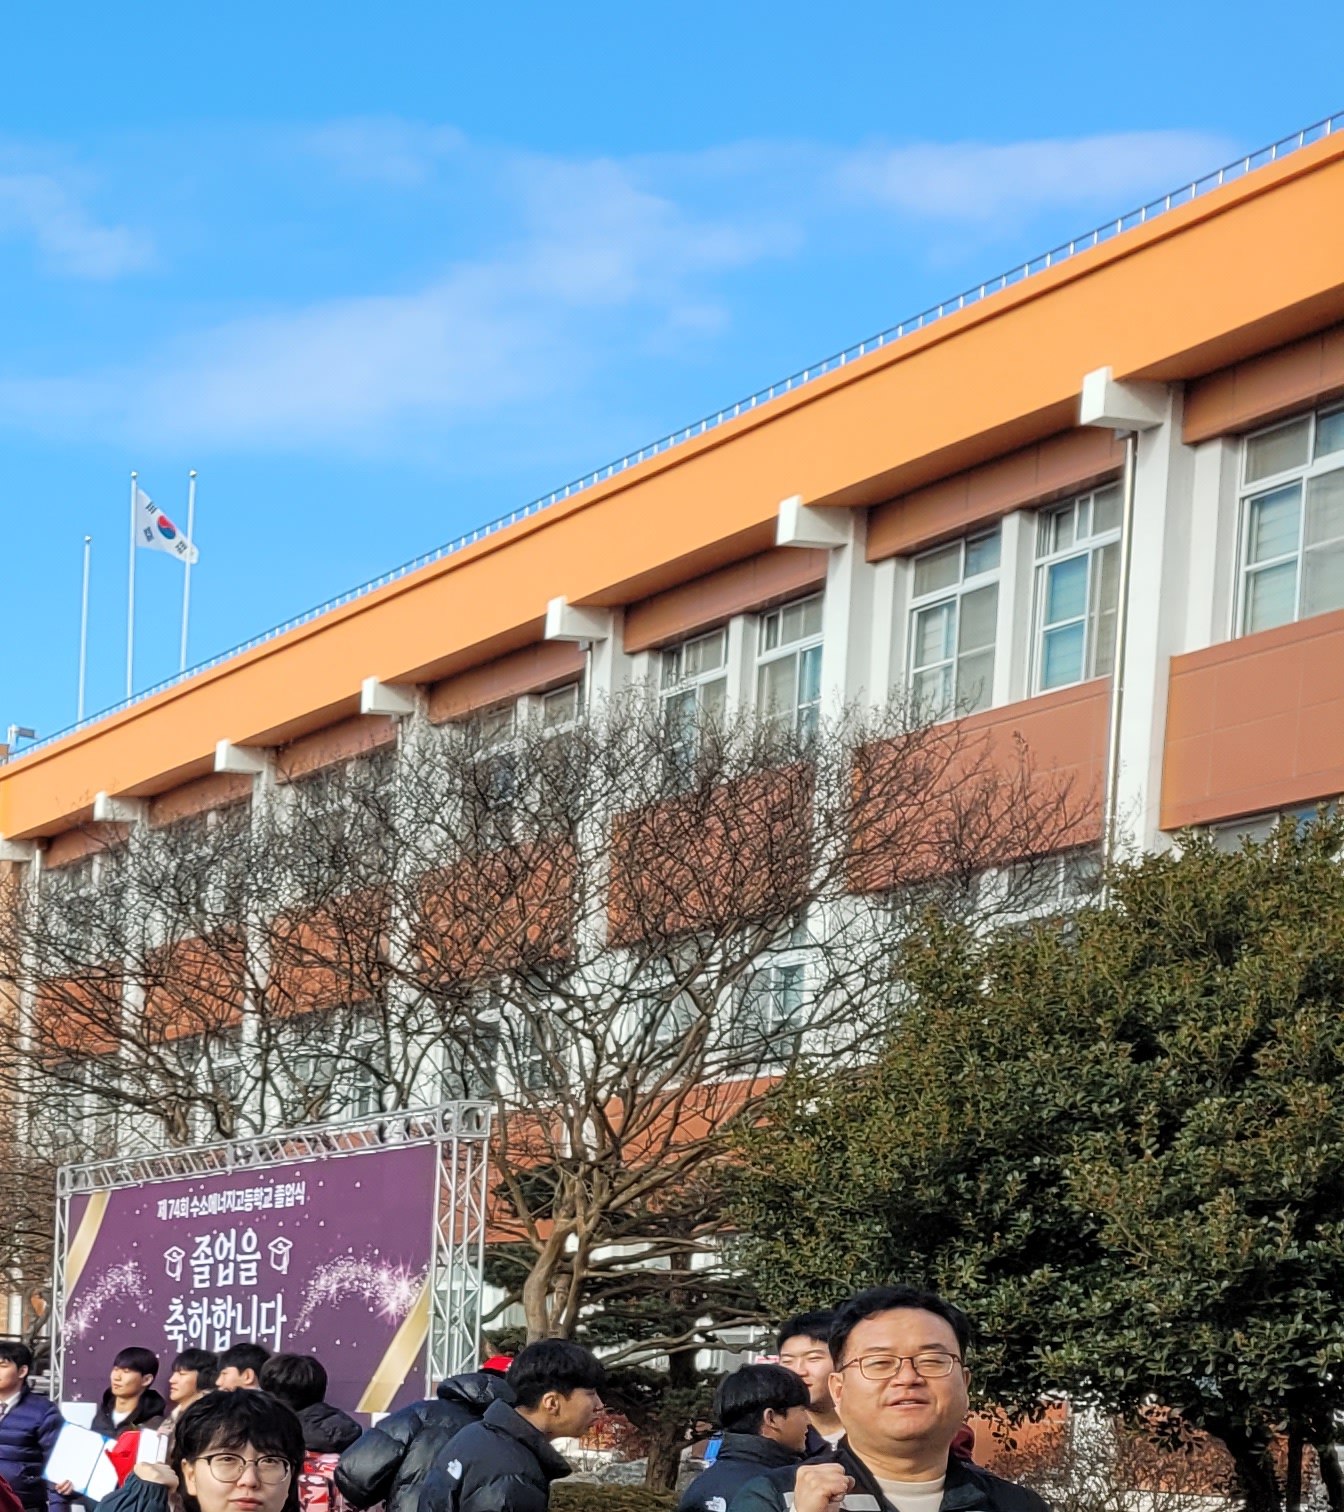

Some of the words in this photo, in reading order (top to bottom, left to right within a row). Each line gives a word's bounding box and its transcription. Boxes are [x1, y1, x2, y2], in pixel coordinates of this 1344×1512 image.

[189, 1186, 273, 1218] 수소에너지고등학교
[274, 1181, 306, 1209] 졸업식
[189, 1227, 262, 1289] 졸업을
[163, 1292, 288, 1353] 축하합니다
